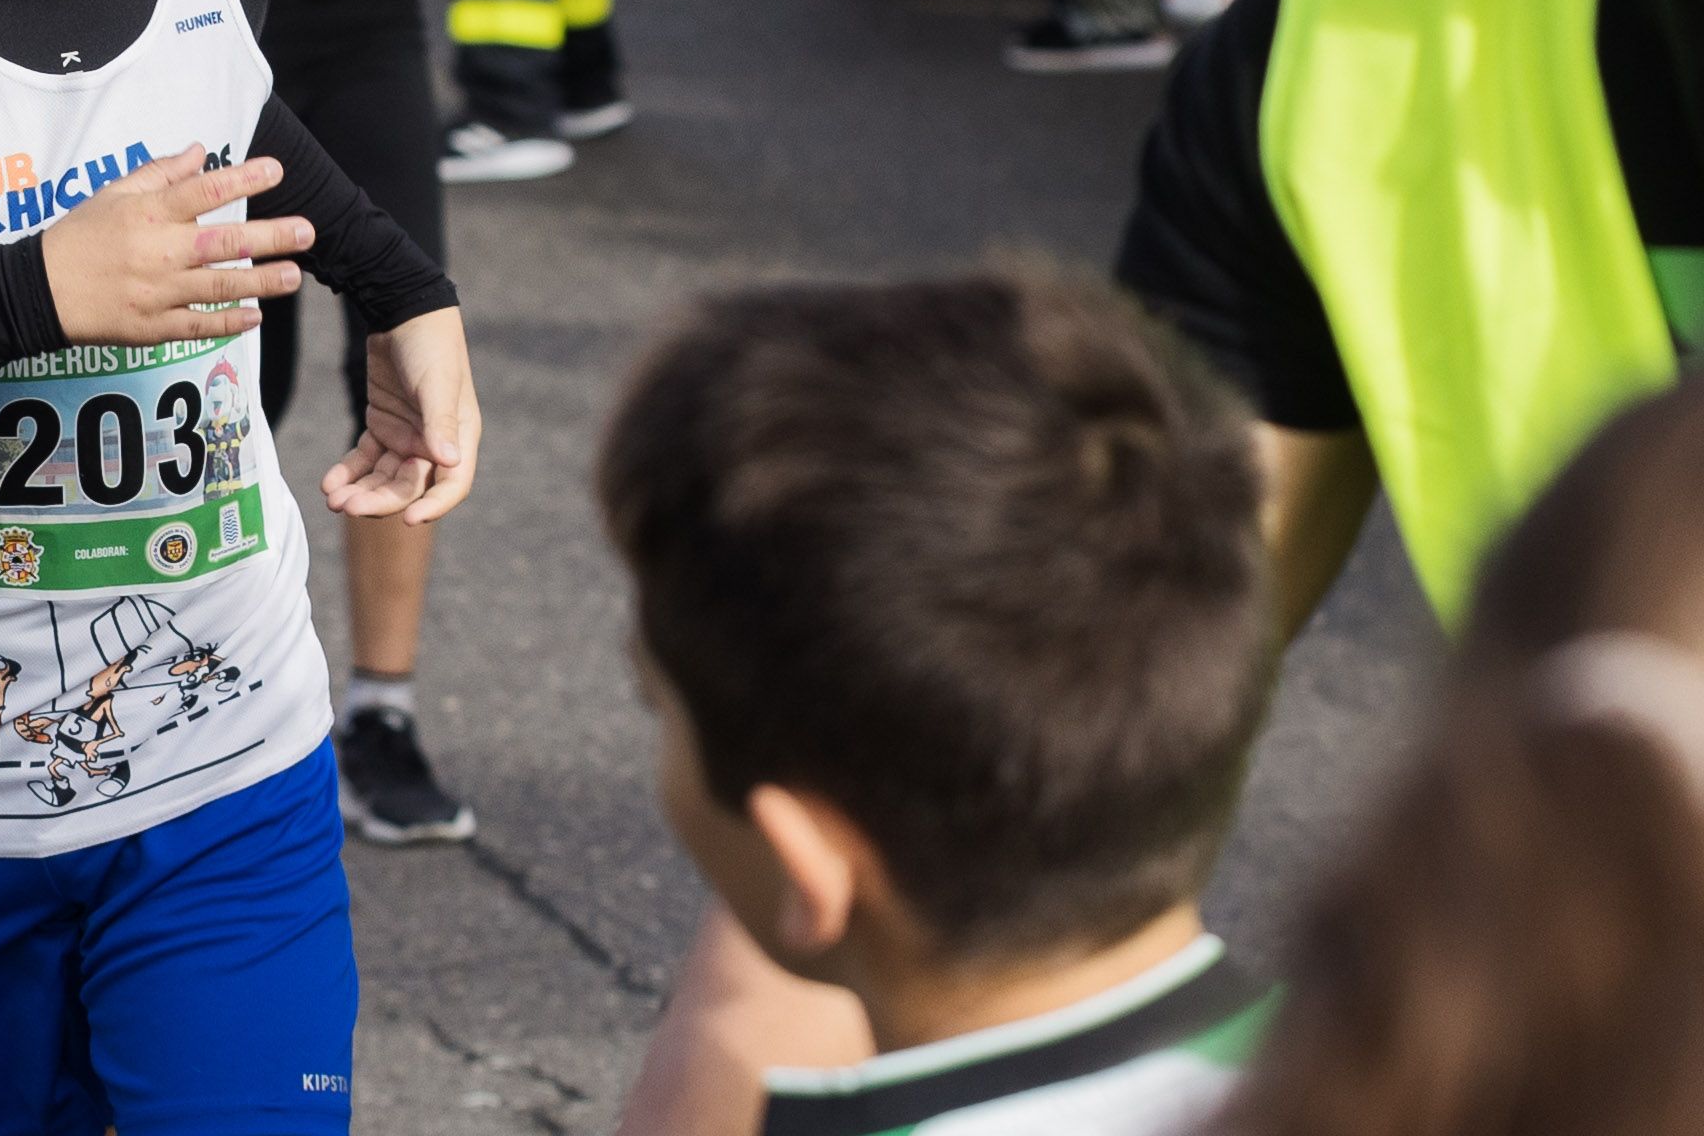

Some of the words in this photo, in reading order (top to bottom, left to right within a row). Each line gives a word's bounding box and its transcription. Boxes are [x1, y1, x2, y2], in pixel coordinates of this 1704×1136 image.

[174, 10, 225, 34] RUNNEK
[126, 344, 157, 369] DE
[74, 546, 129, 560] COLABORAN:
[68, 716, 86, 736] 5
